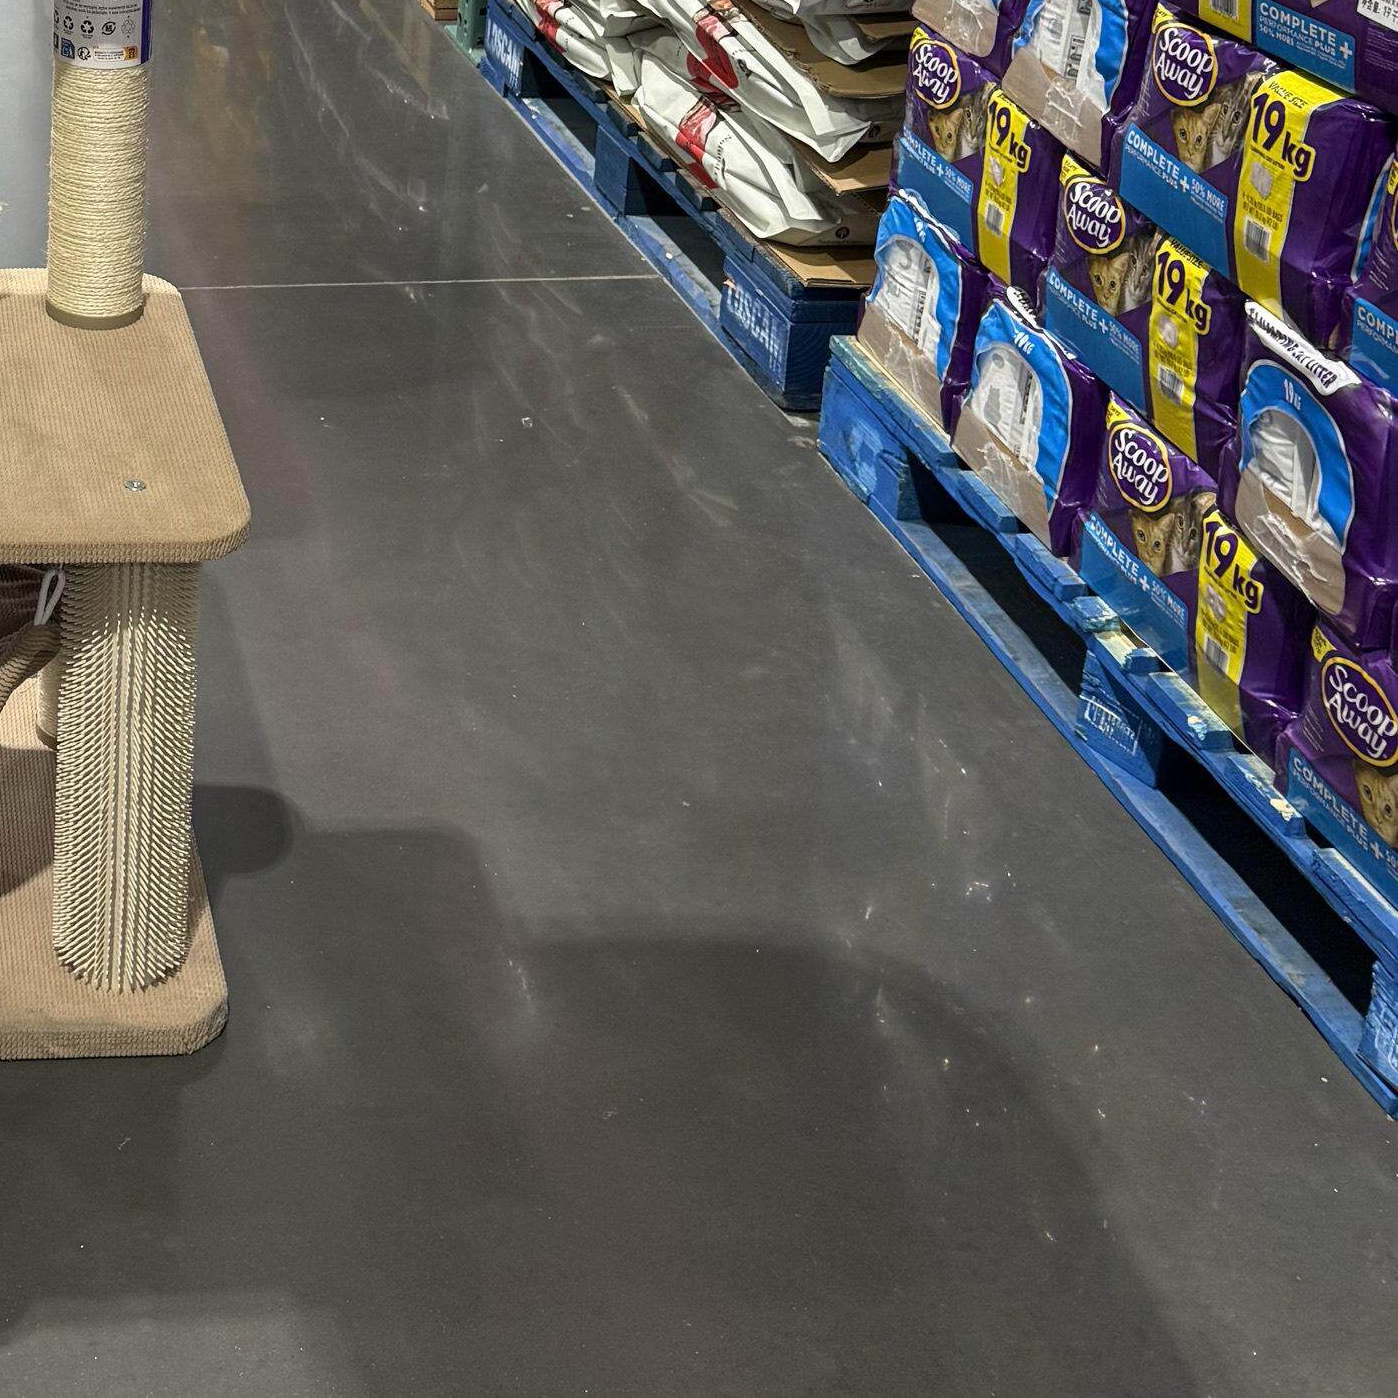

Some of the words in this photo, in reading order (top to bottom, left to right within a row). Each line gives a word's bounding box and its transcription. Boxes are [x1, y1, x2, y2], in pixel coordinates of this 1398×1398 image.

[1258, 24, 1276, 39] 50%
[1276, 29, 1295, 47] MORE
[1259, 15, 1313, 47] PERFORMANCE
[1313, 37, 1336, 57] PLUS
[1260, 2, 1337, 45] COMPLETE
[1268, 81, 1291, 101] VALUE
[1126, 130, 1180, 181] COMPLETE
[1161, 169, 1179, 189] PLUS
[1206, 188, 1225, 212] MORE
[1049, 271, 1098, 320] COMPLETE
[1294, 757, 1368, 838] COMPLETE
[1346, 824, 1369, 852] PLUS
